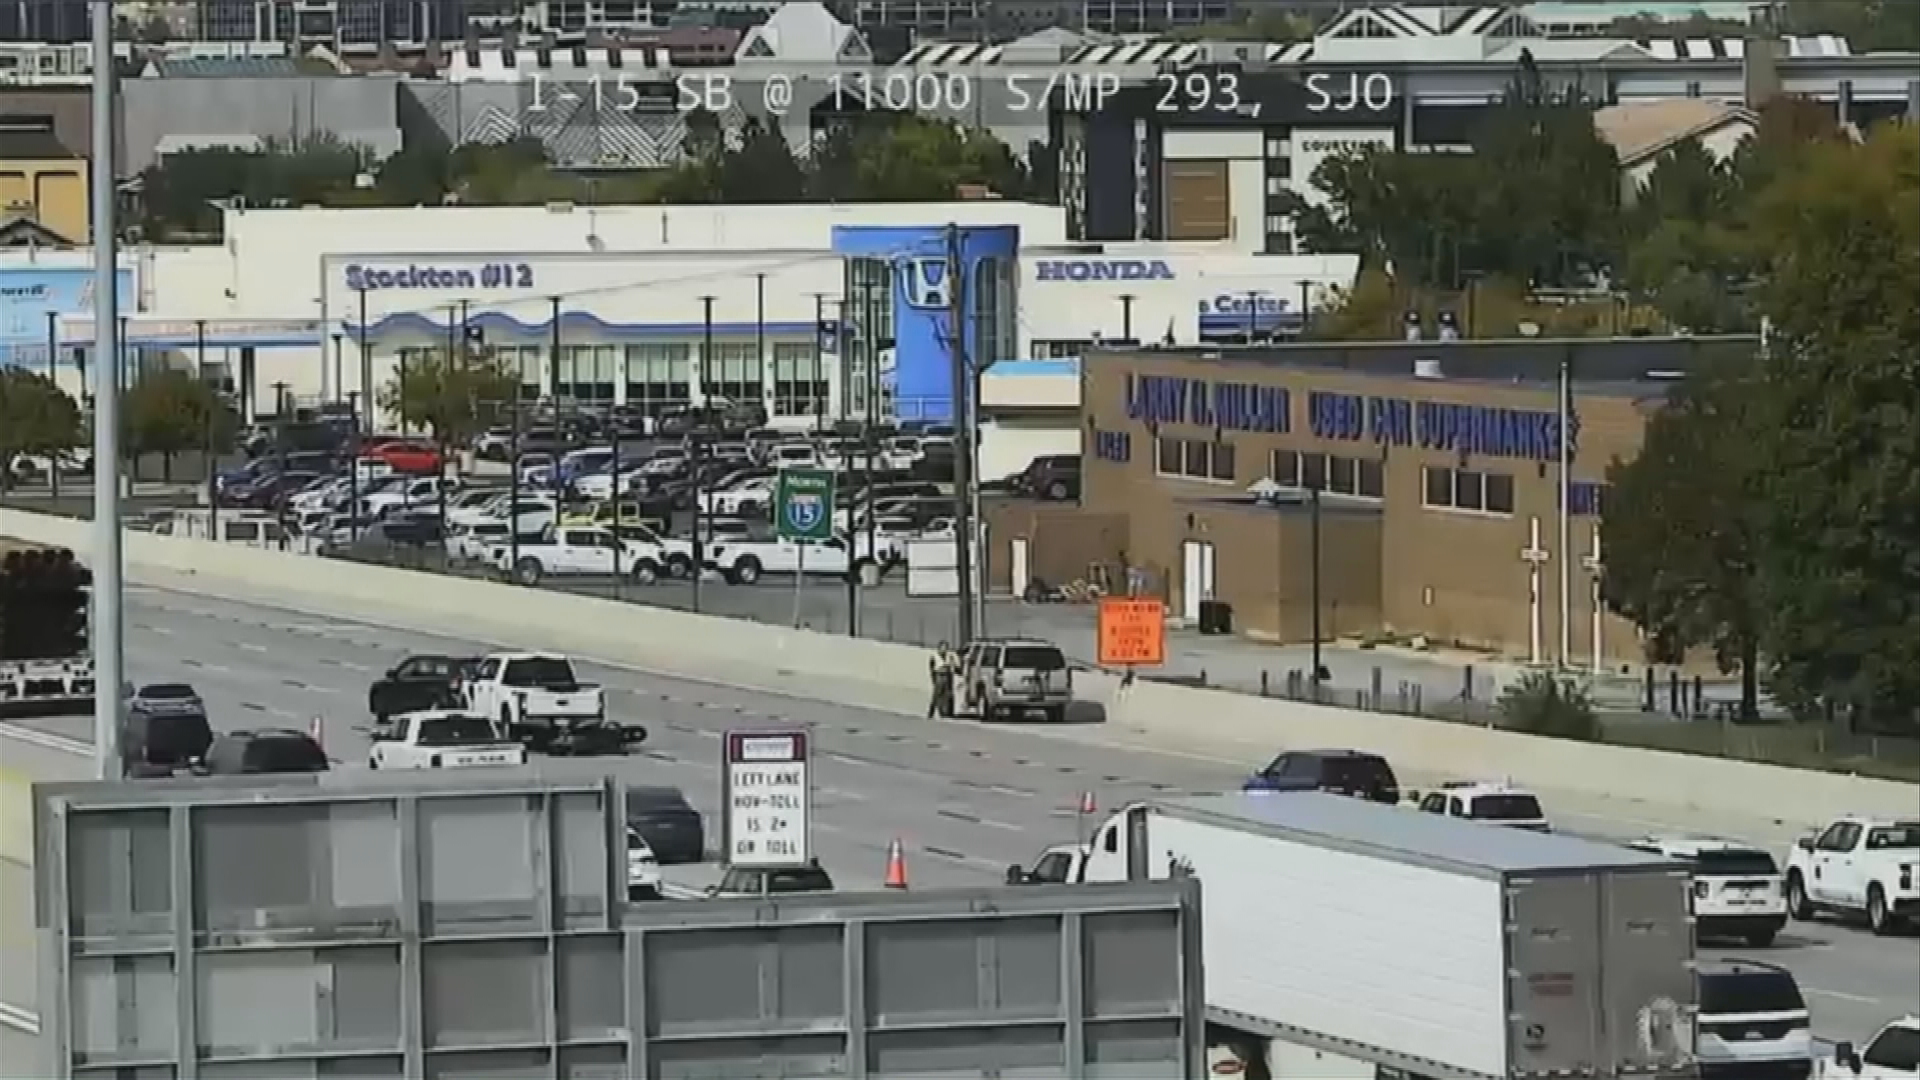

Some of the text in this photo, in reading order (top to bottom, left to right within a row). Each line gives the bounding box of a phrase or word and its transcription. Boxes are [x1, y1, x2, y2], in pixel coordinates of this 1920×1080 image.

[345, 264, 474, 290] Stockton
[1036, 260, 1175, 281] HONDA
[1214, 294, 1290, 313] Center
[1308, 390, 1568, 462] USED CAR SUPERMARKE
[795, 503, 816, 523] 15
[733, 771, 801, 787] LEFT LANE
[733, 794, 801, 809] HOV-TOLL
[736, 840, 798, 855] OR TOLL
